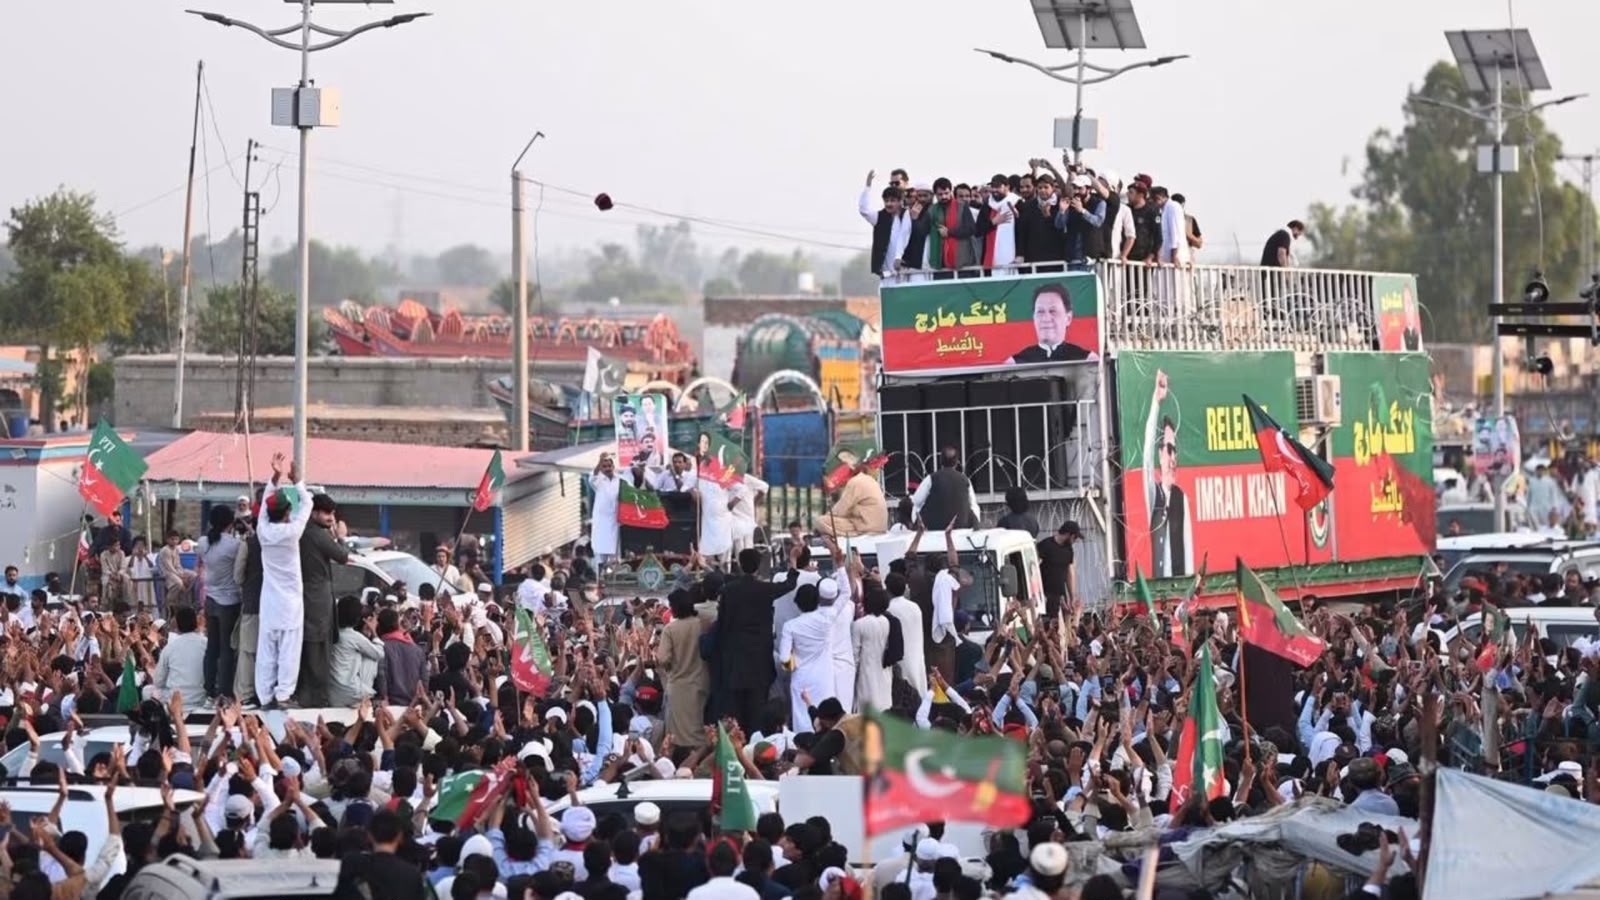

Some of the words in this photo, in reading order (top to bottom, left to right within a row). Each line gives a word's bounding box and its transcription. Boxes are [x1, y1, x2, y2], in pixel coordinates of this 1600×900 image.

[915, 306, 957, 333] مارچ
[960, 301, 1007, 326] لانگ
[98, 435, 116, 453] PTI
[1206, 405, 1268, 451] RELEA
[1353, 407, 1383, 467] مارچ
[1383, 400, 1415, 453] لانگ
[1195, 475, 1245, 522] IMRAN
[1247, 471, 1287, 518] KHAN
